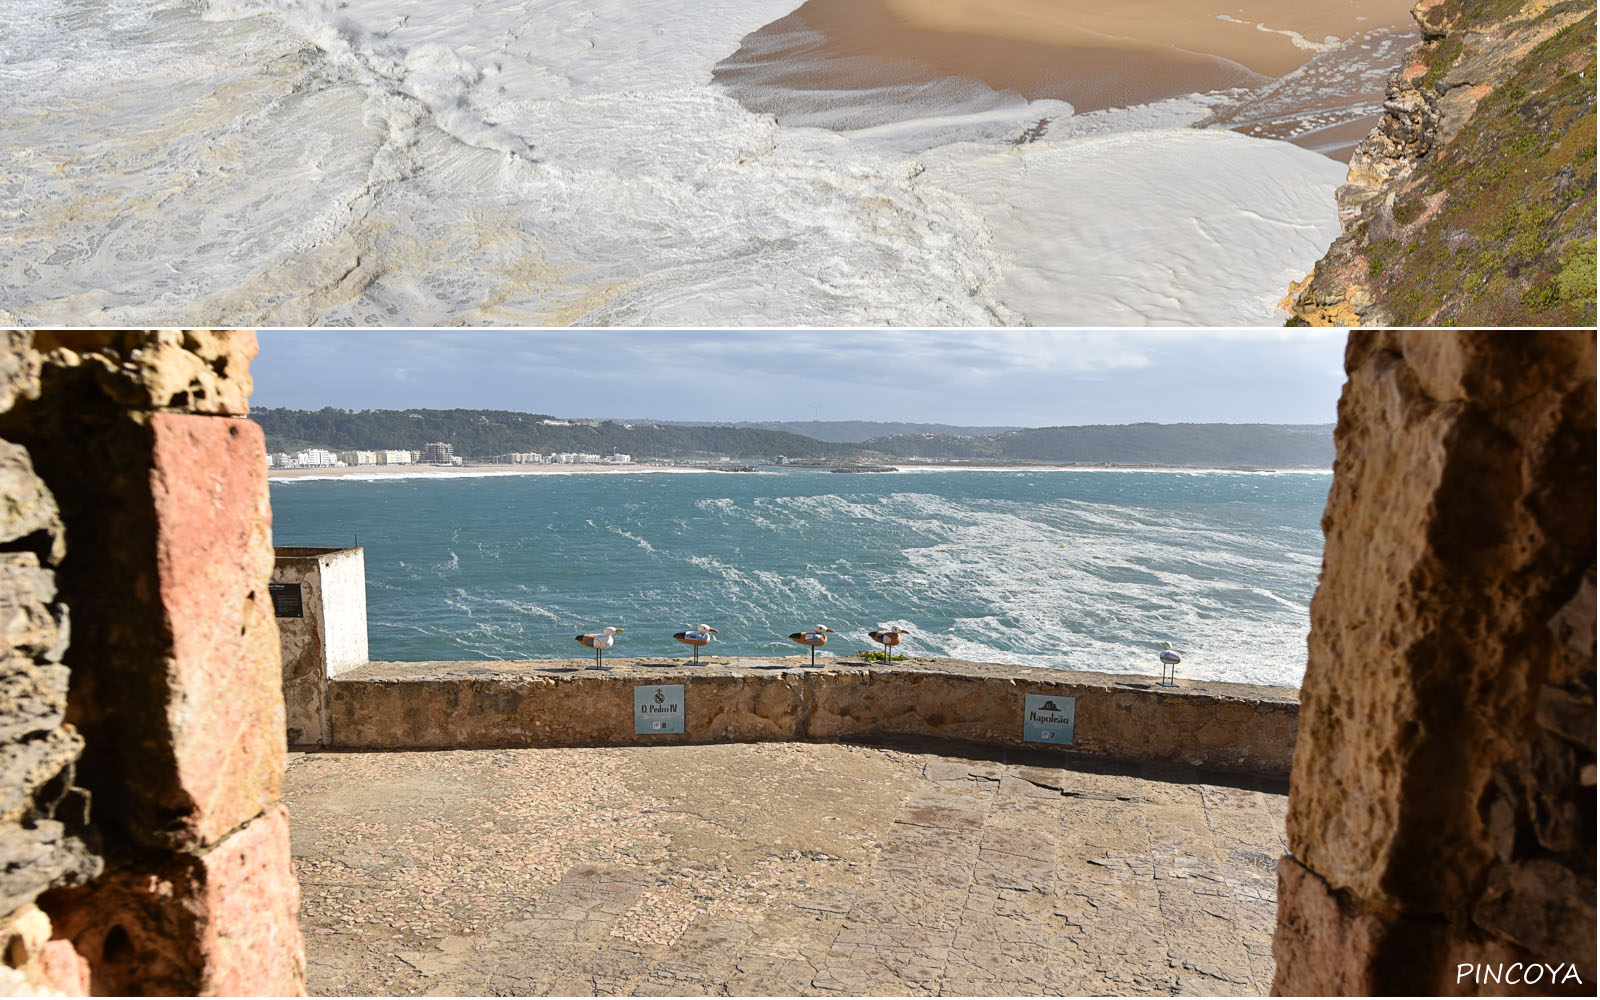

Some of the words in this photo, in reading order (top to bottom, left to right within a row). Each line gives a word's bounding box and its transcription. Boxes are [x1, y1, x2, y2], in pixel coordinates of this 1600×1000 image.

[649, 704, 669, 713] Pedro
[670, 703, 678, 713] IV
[1029, 711, 1069, 725] Napoleão
